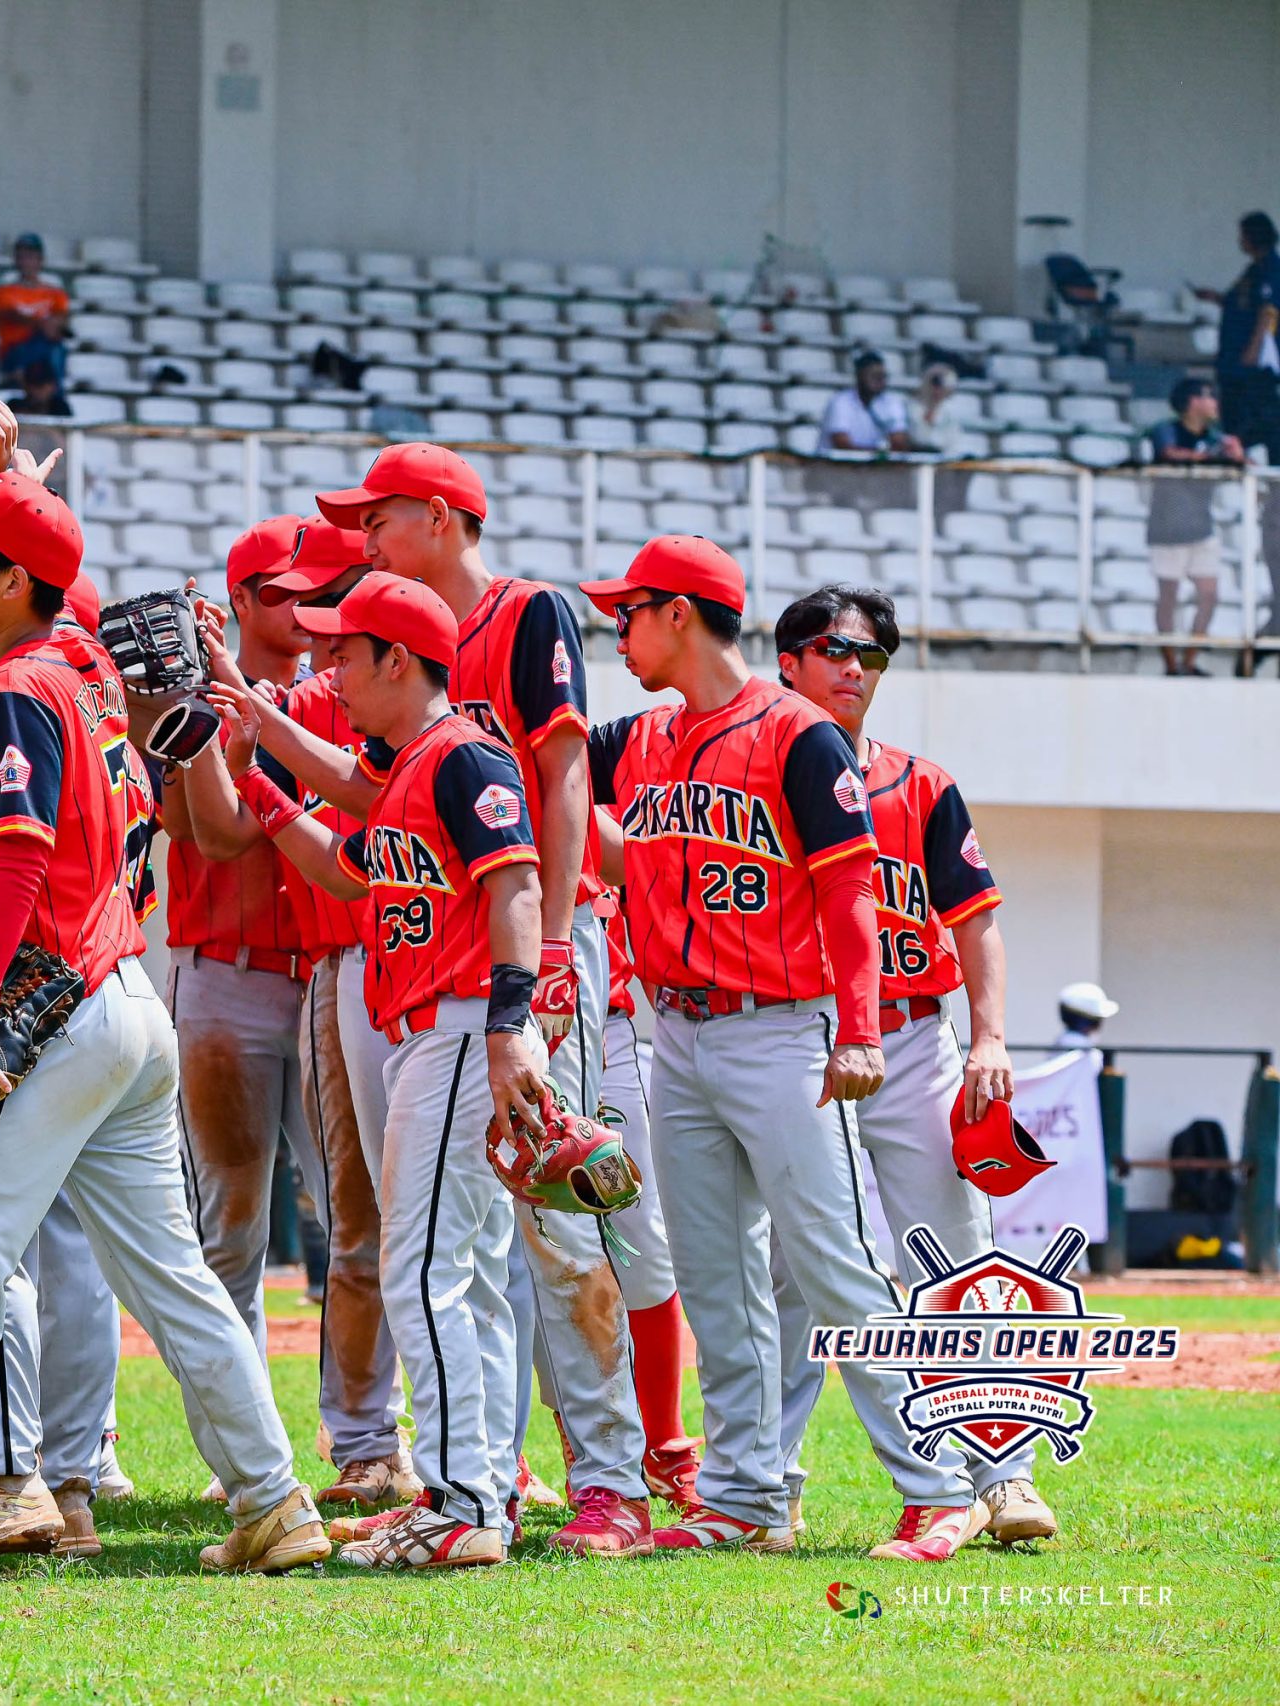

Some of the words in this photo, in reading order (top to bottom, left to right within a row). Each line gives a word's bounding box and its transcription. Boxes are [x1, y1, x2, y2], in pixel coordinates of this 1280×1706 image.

[699, 861, 769, 914] 28
[380, 893, 435, 954] 39
[877, 927, 931, 977] 16
